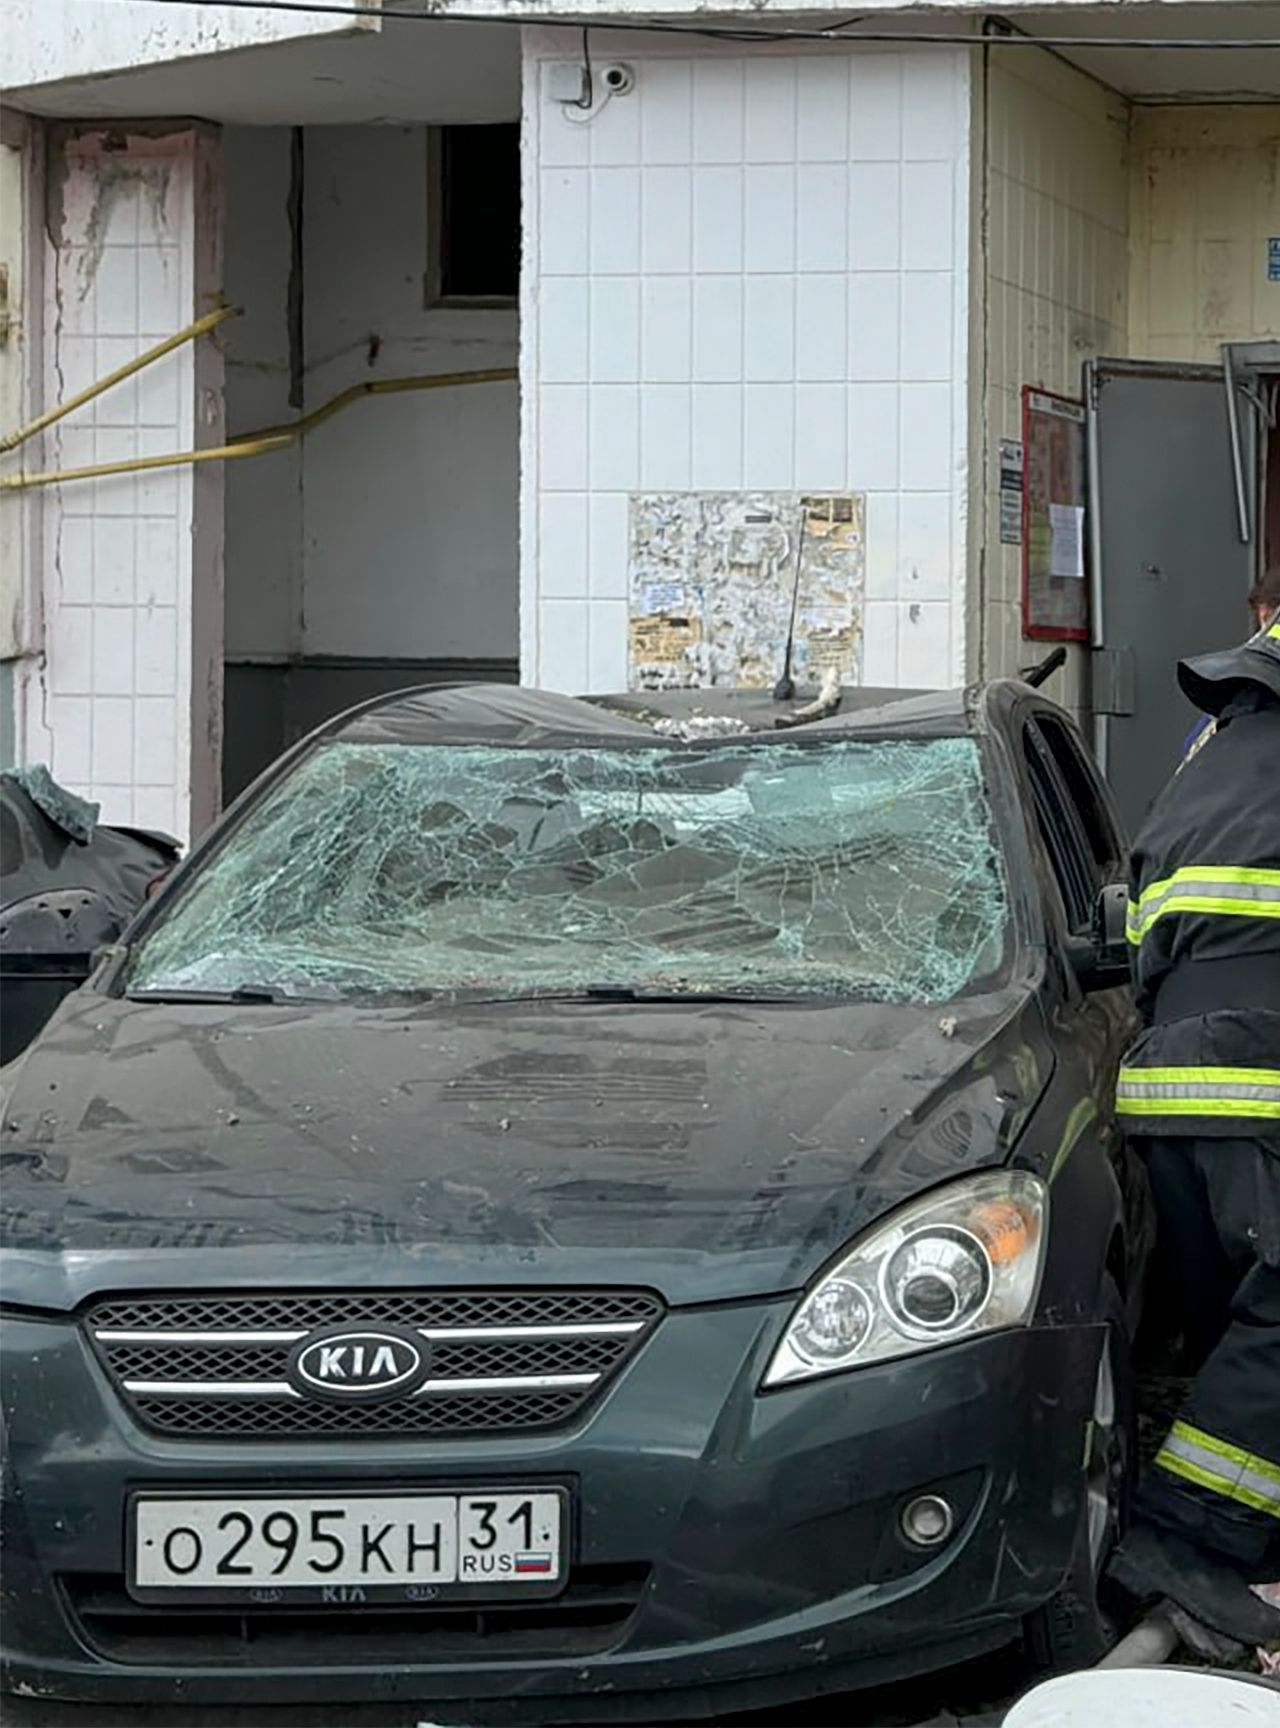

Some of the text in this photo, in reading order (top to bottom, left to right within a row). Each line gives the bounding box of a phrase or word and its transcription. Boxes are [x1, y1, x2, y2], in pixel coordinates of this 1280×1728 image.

[318, 1345, 398, 1379] KIA
[469, 1501, 532, 1550] 31
[462, 1554, 512, 1574] RUS
[322, 1586, 367, 1602] KIA
